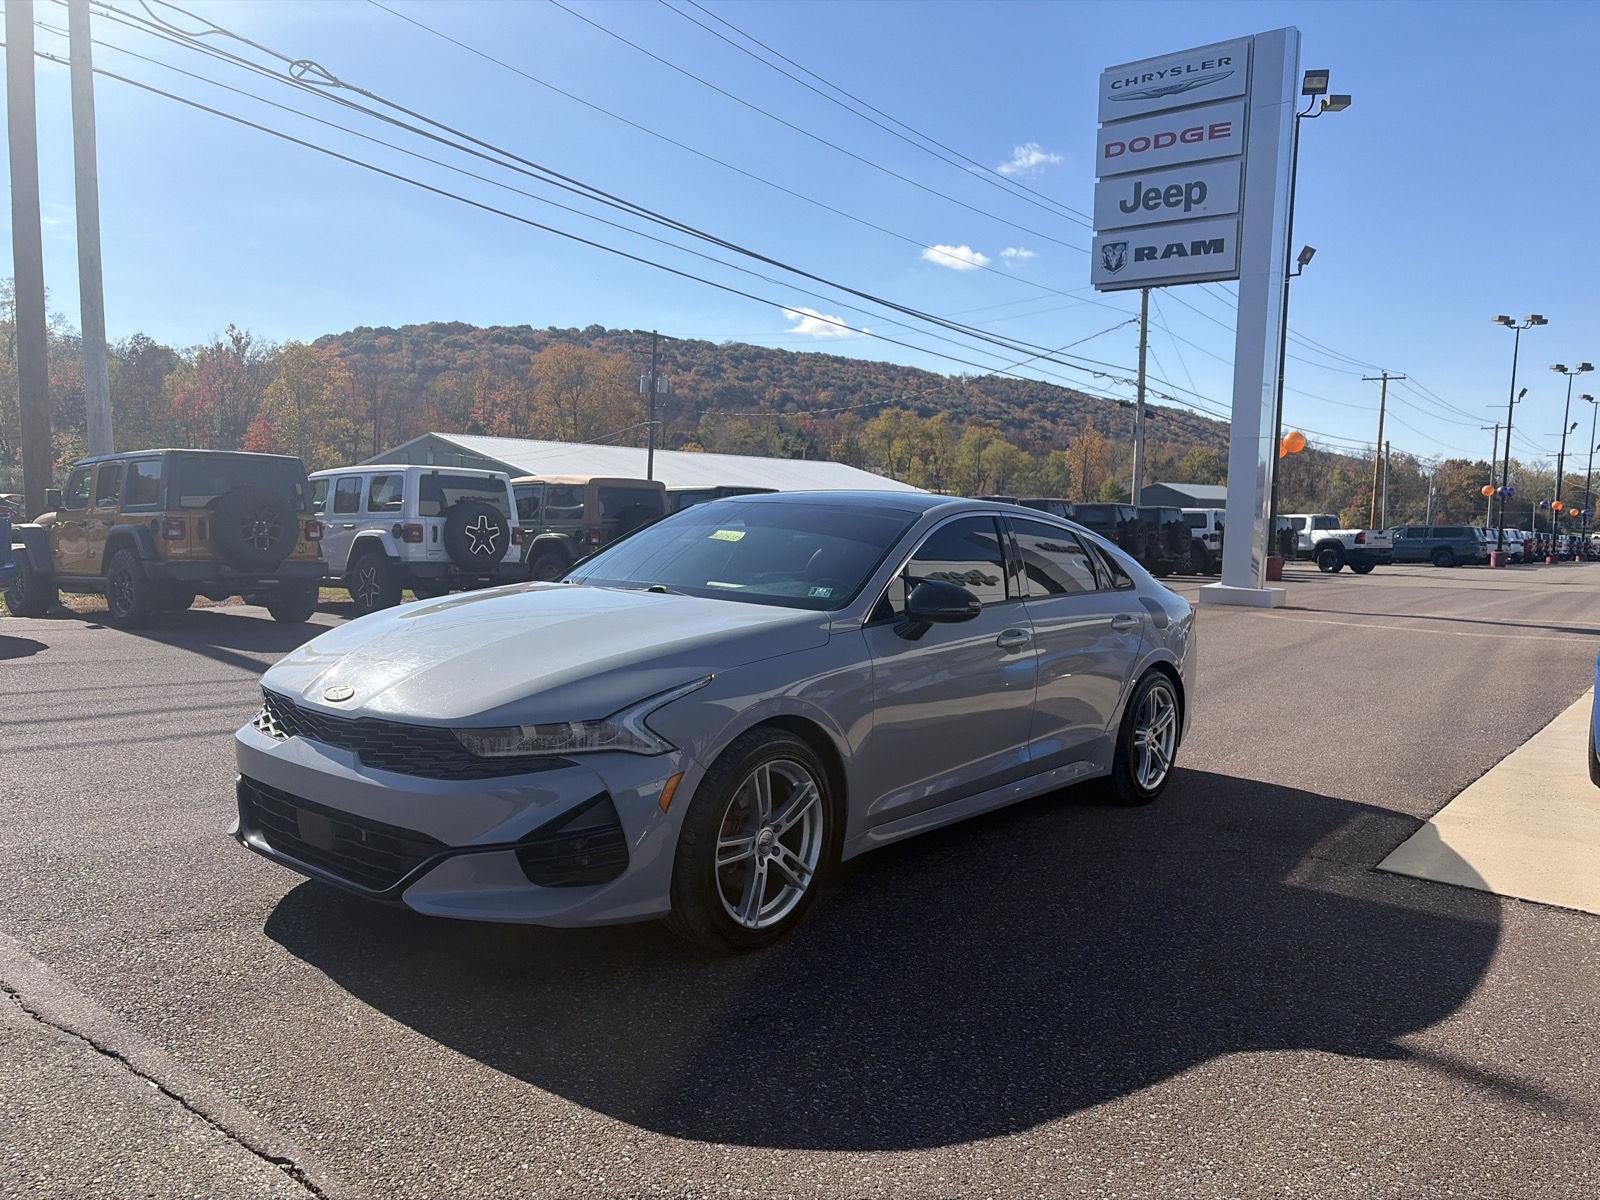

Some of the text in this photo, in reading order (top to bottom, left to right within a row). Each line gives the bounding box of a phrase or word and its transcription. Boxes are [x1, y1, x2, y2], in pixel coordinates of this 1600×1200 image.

[1110, 56, 1232, 90] CHRYSLER
[1104, 121, 1232, 159] DODGE
[1119, 180, 1208, 214] Jeep
[1134, 237, 1225, 262] RAM
